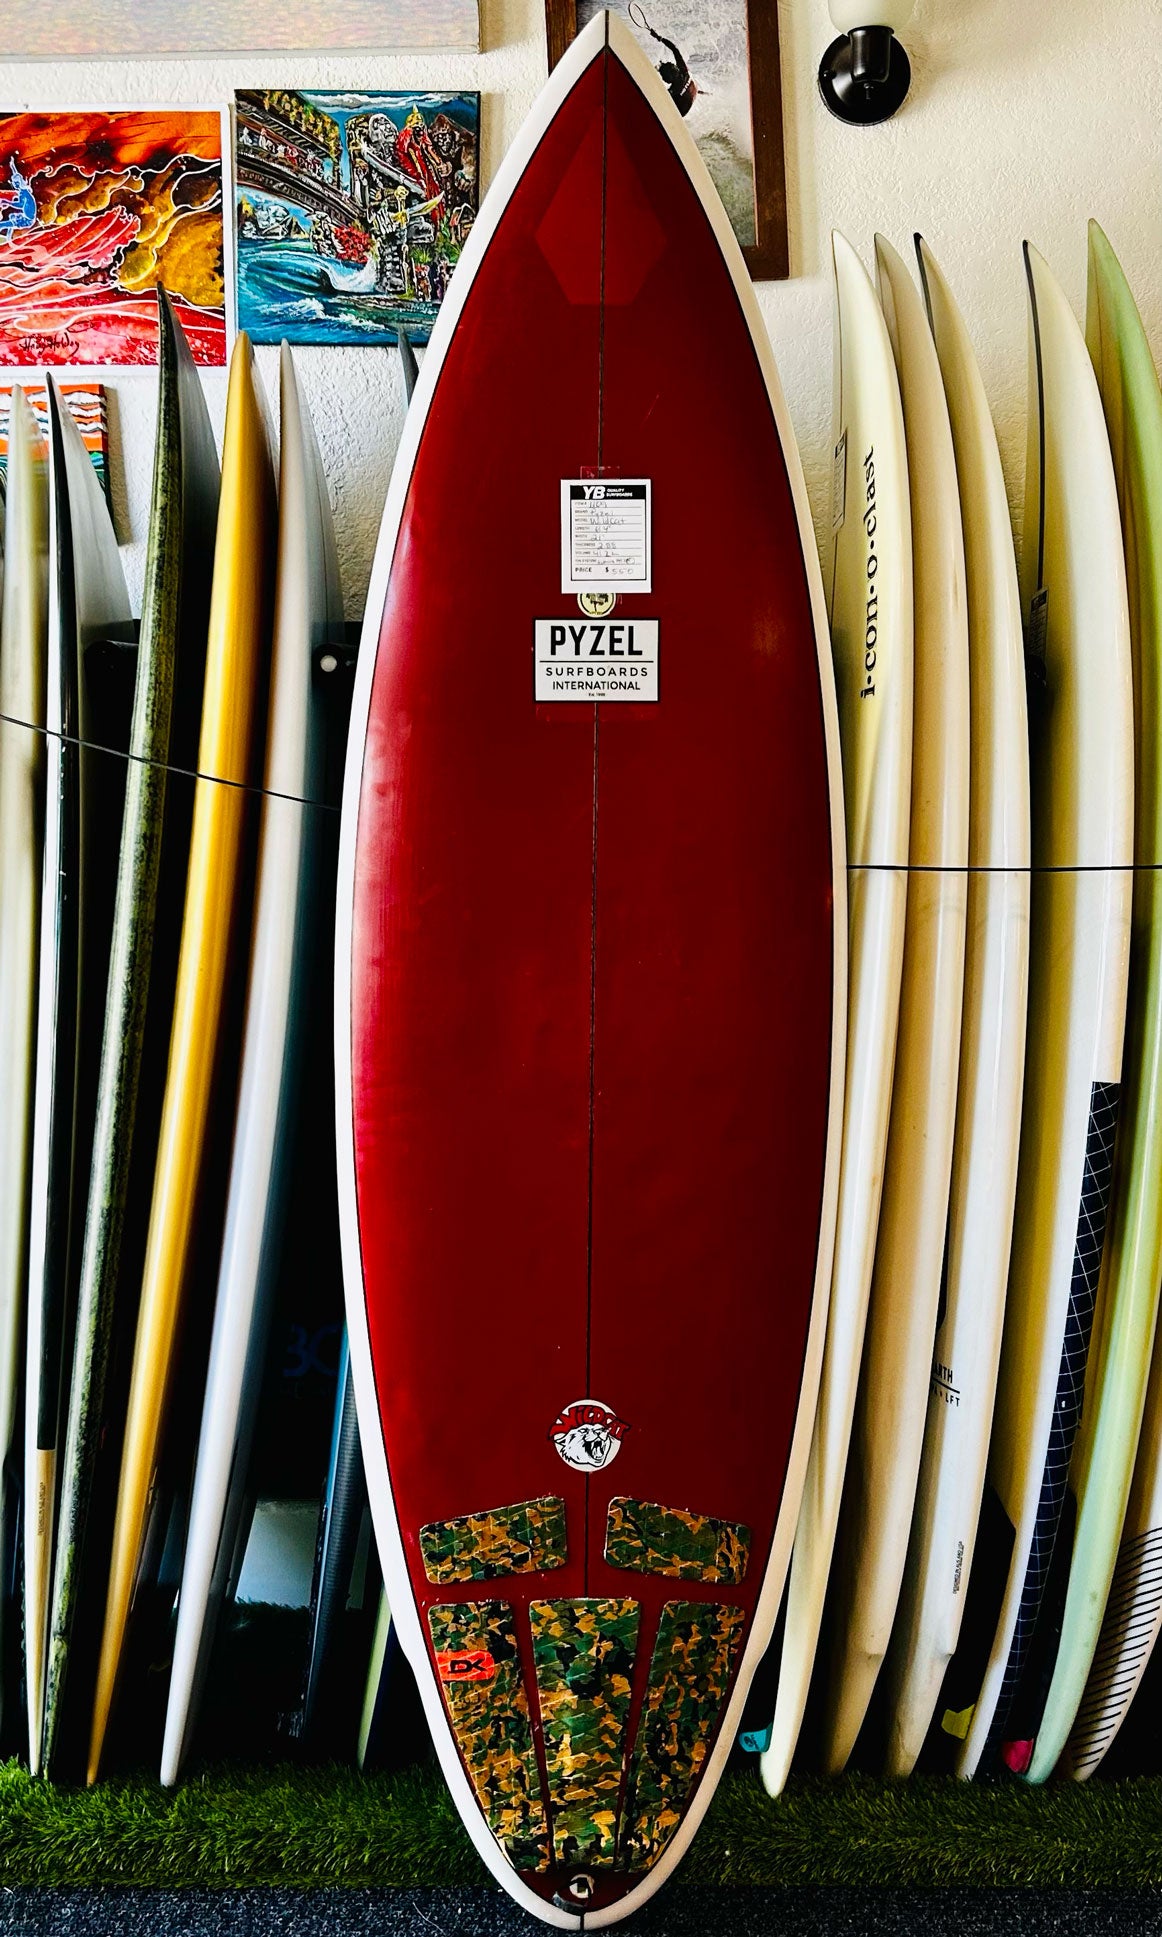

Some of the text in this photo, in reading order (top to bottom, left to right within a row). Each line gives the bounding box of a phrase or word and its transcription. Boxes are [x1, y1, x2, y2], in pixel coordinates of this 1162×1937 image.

[583, 486, 605, 499] YB
[550, 625, 643, 656] PYZEL
[546, 667, 648, 677] SURFBOARDS
[552, 681, 641, 690] INTERNATIONAL
